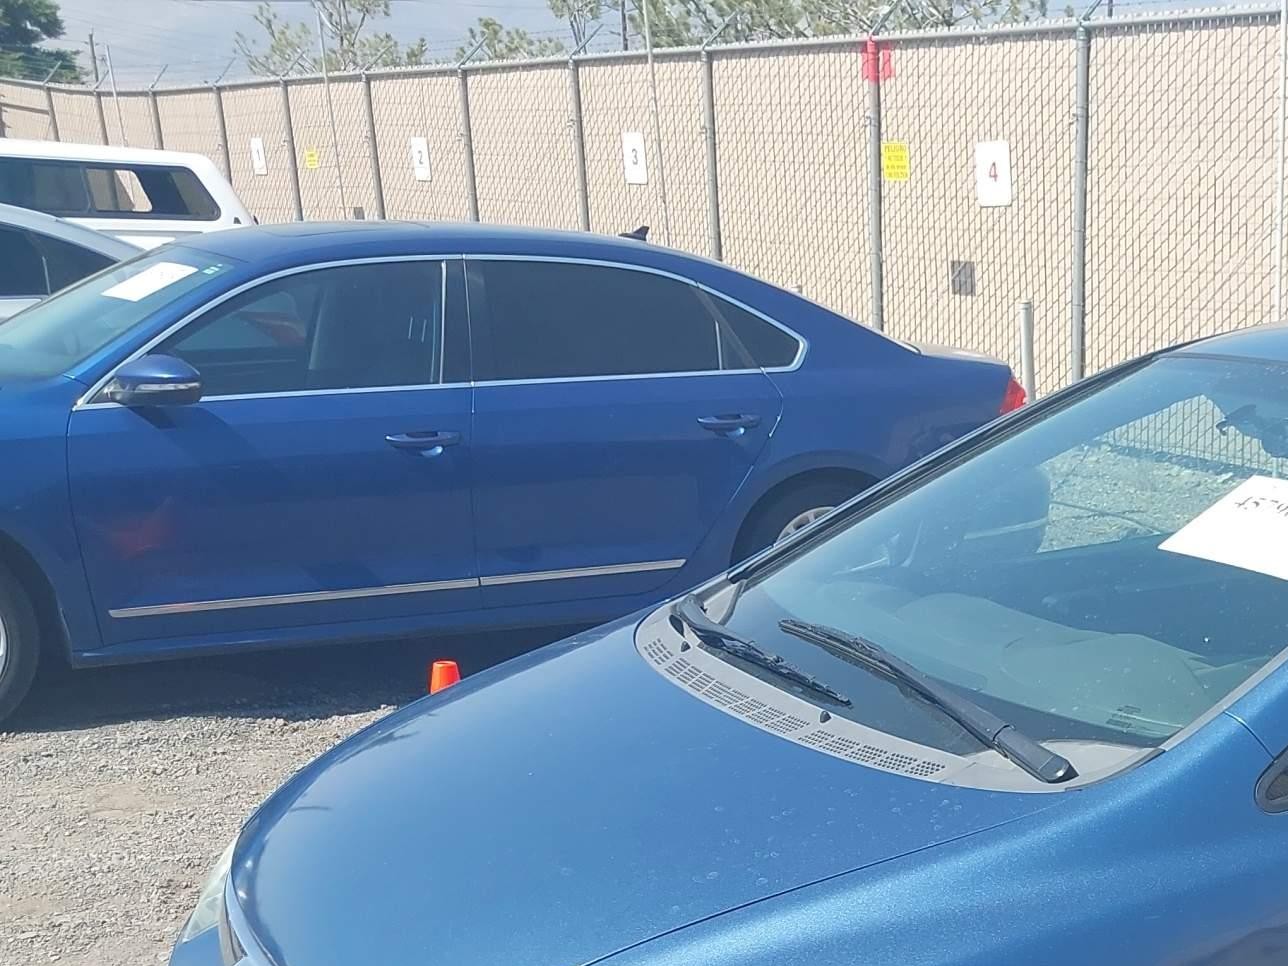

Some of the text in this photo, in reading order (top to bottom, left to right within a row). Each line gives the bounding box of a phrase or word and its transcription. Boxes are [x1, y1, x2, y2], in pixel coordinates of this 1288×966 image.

[417, 149, 424, 165] 2
[631, 148, 638, 166] 3
[989, 161, 998, 182] 4
